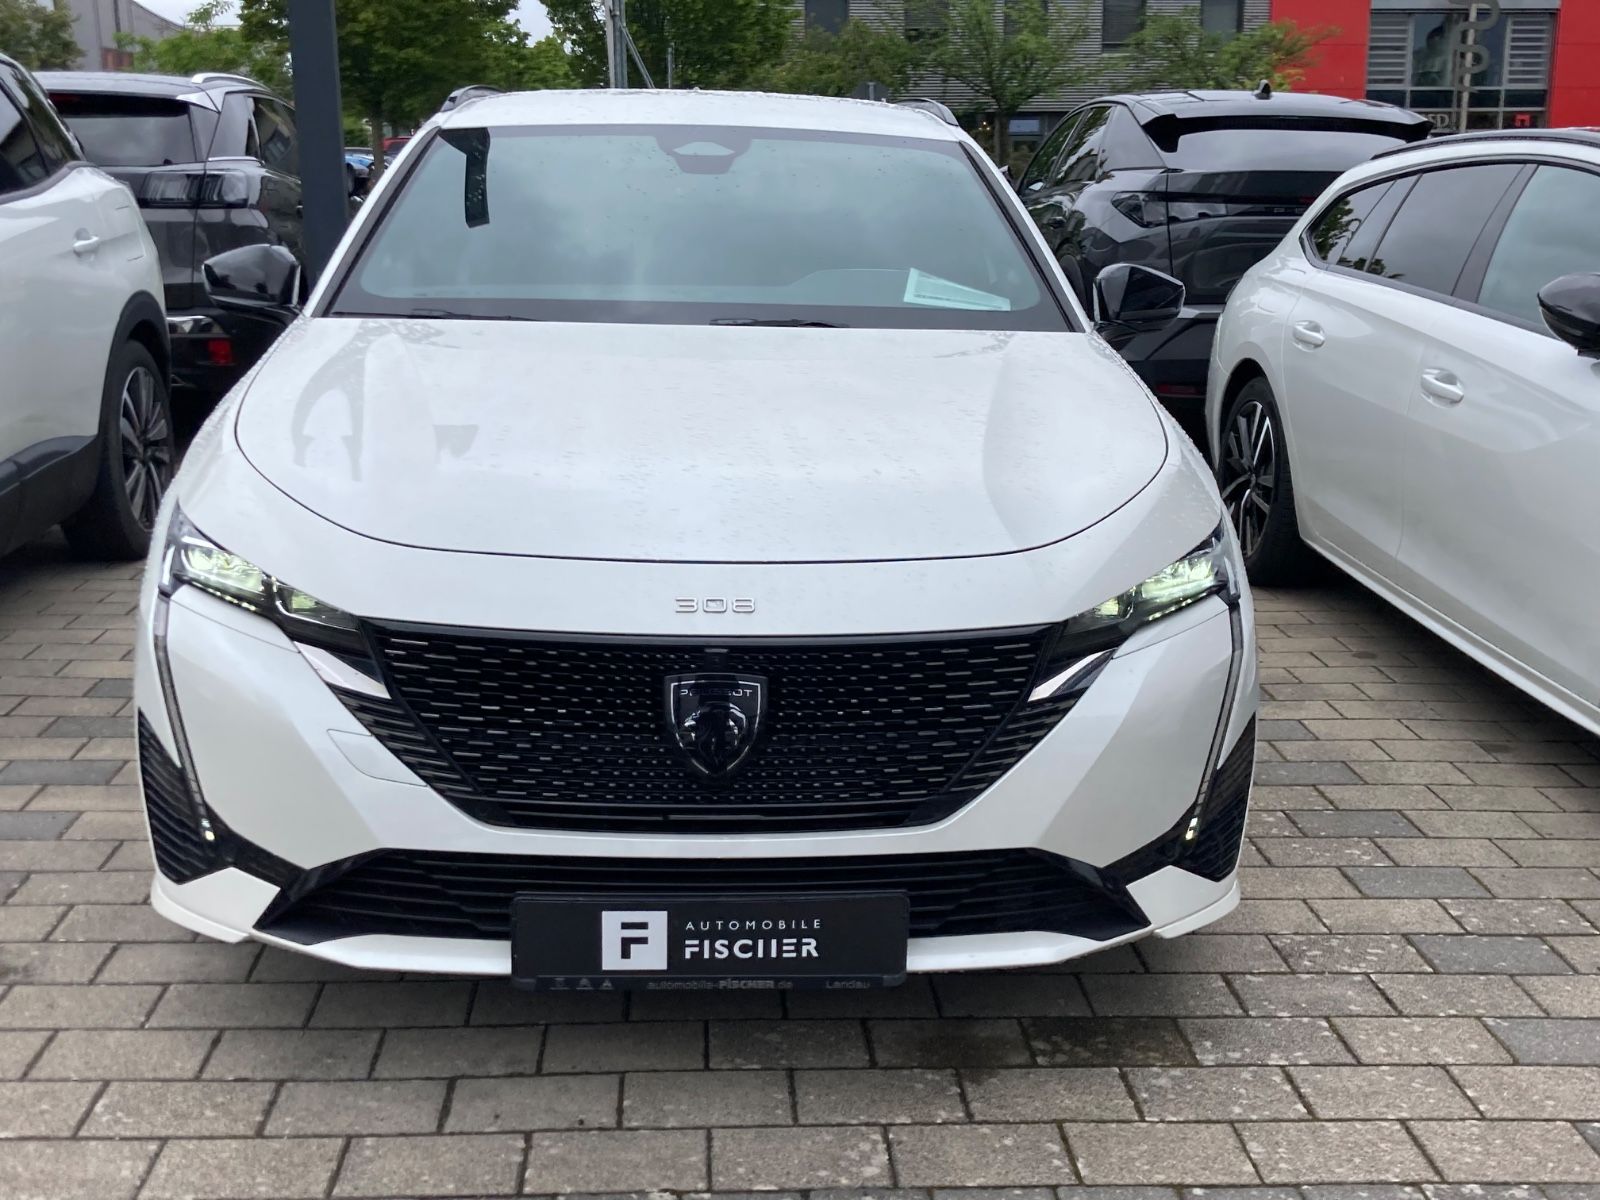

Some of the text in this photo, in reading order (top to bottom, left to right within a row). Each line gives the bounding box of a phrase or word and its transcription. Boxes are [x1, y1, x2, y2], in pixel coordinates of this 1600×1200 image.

[674, 597, 756, 614] 308
[685, 918, 822, 932] AUTOMOBILE
[684, 938, 819, 960] FISCHER
